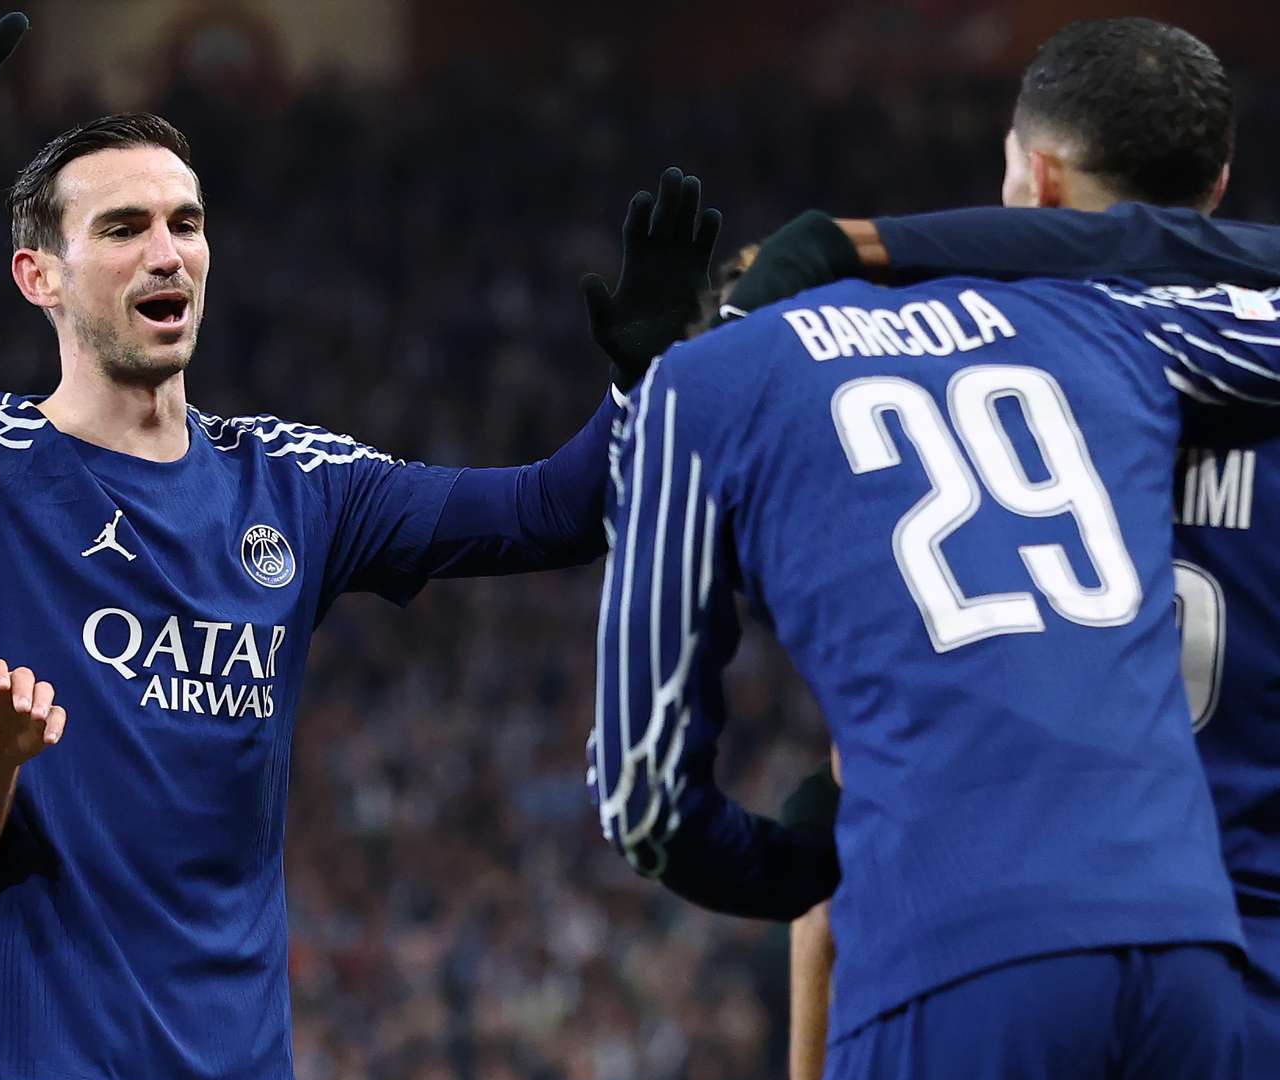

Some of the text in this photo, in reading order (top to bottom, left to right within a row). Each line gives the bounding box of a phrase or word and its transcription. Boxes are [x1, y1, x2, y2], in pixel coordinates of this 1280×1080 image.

[783, 288, 1017, 362] BARCOLA
[830, 363, 1143, 654] 29
[1174, 449, 1256, 530] IMI
[246, 528, 280, 545] PARIS
[82, 607, 287, 680] QATAR
[140, 674, 274, 719] AIRWAYS
